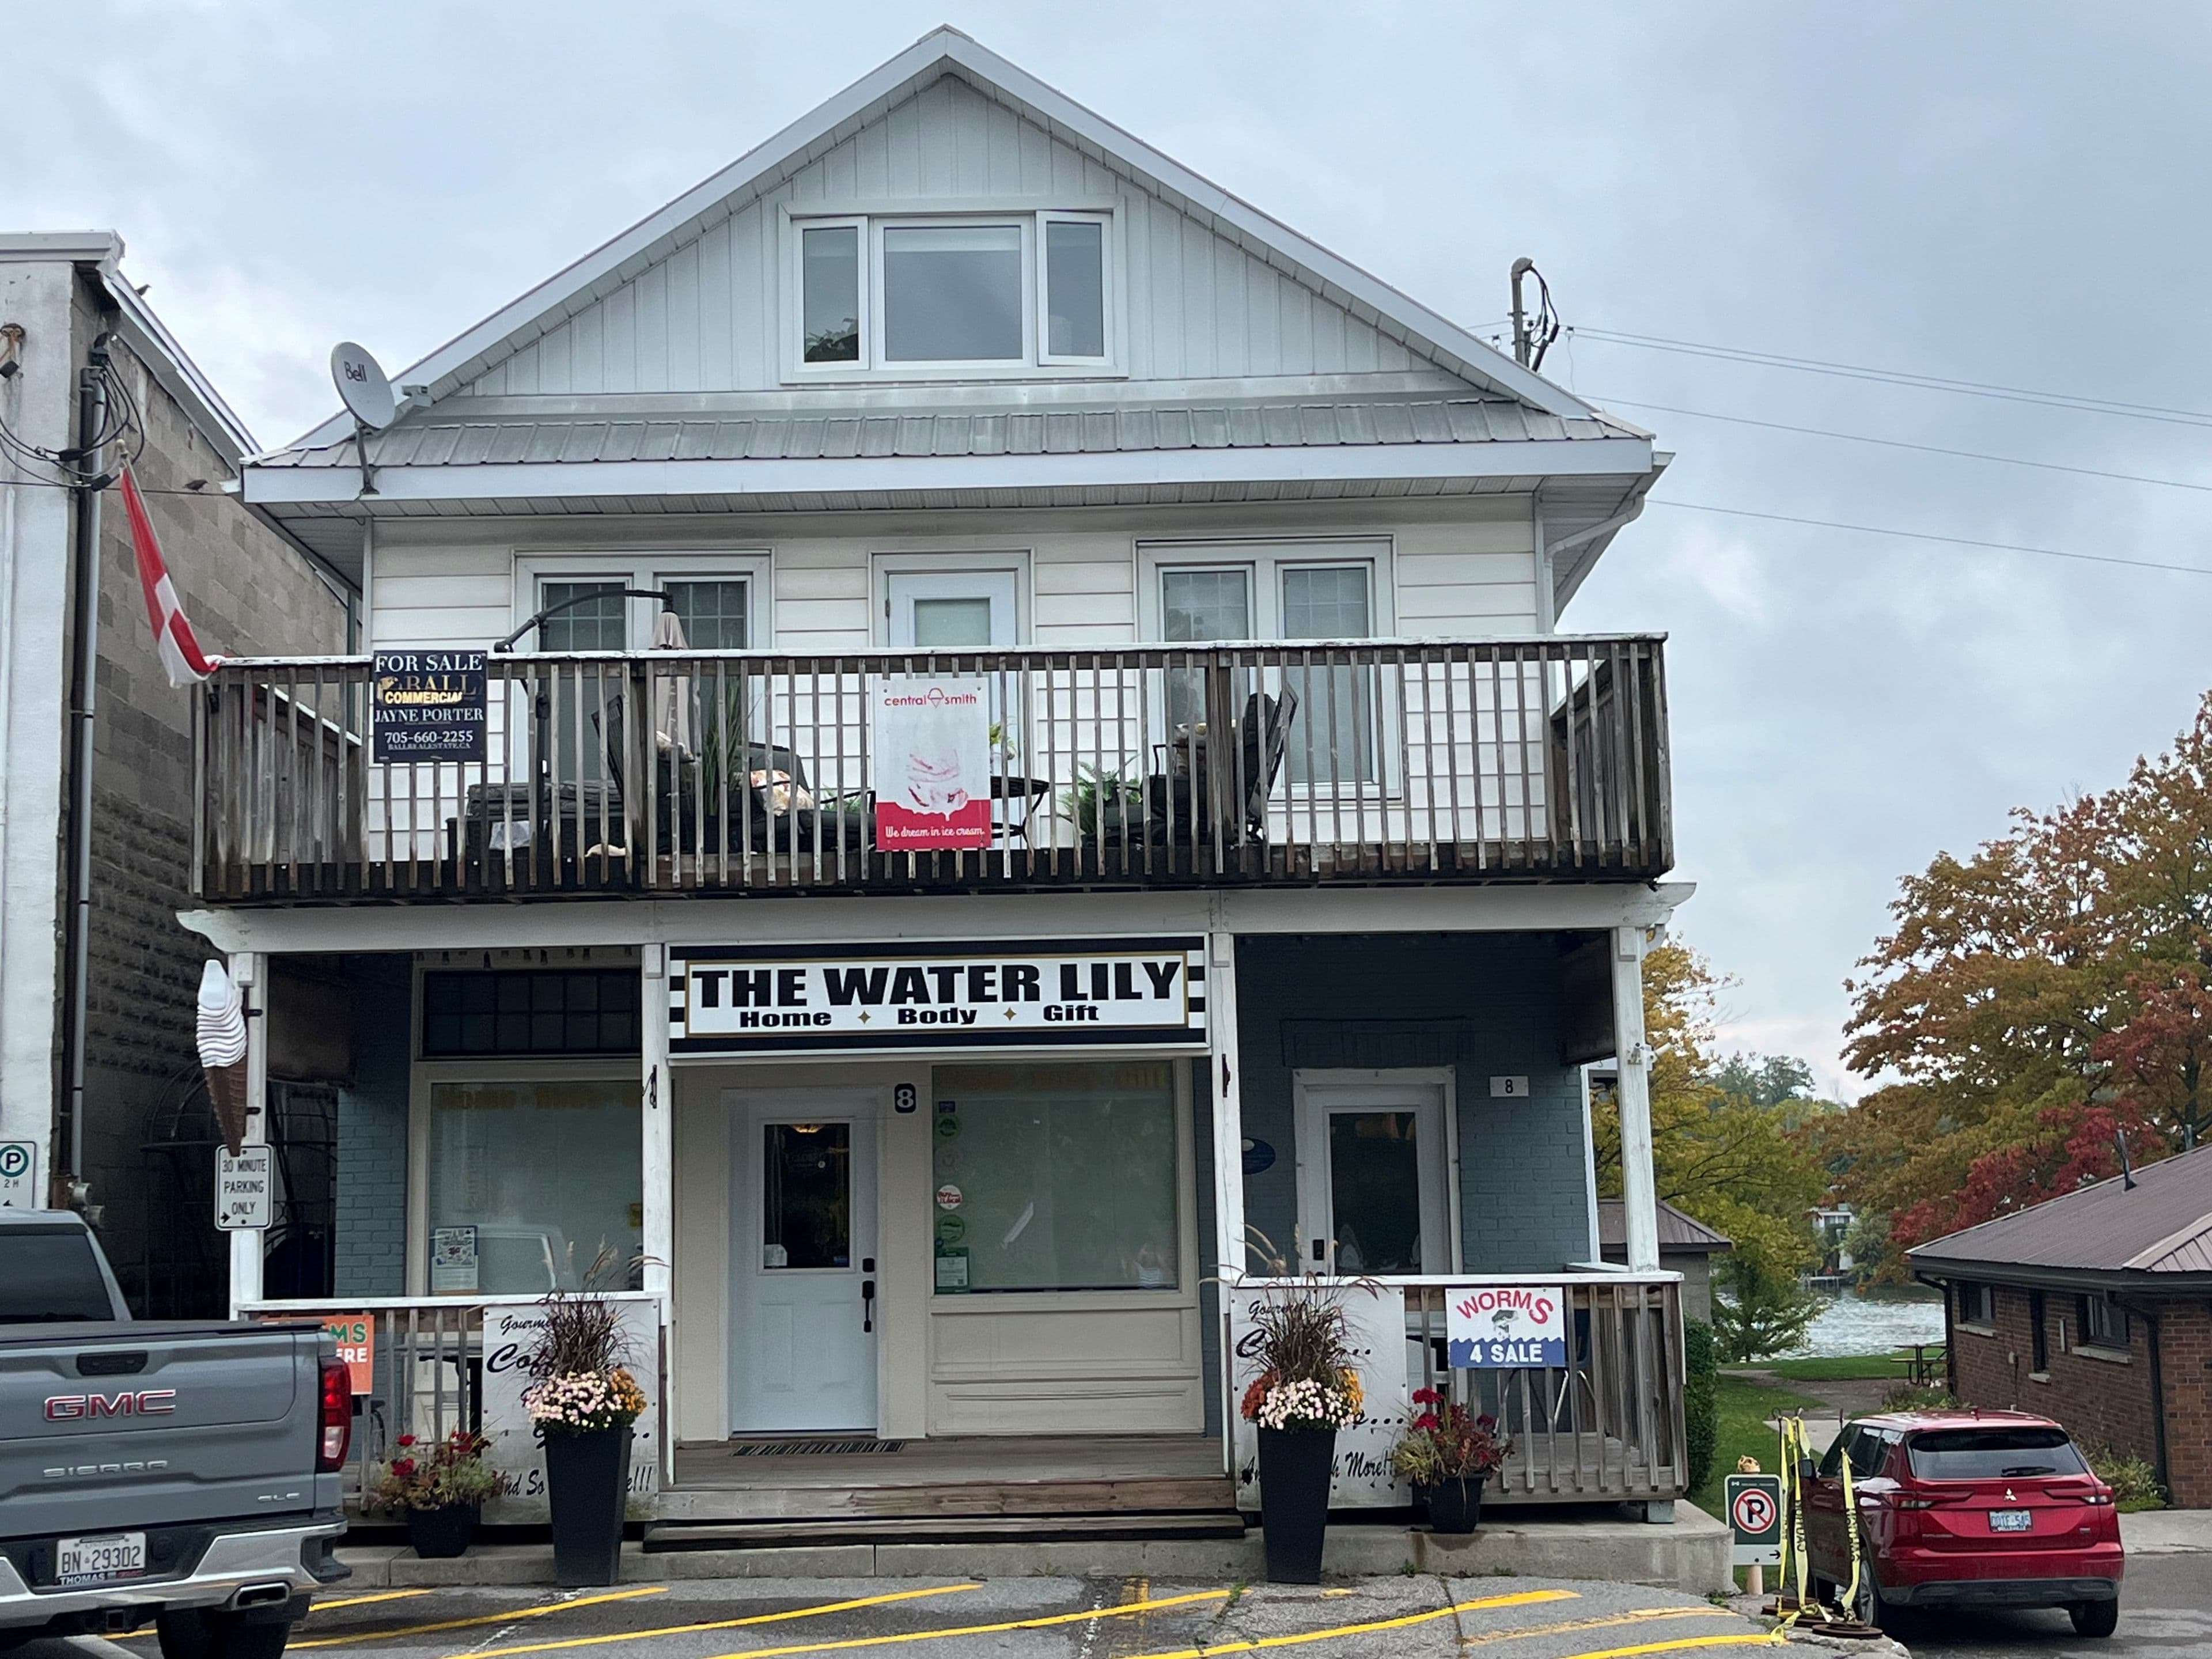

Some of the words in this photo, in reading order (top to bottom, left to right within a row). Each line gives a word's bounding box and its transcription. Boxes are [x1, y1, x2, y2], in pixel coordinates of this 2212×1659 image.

[344, 361, 367, 382] Bell
[375, 656, 419, 672] FOR
[426, 654, 482, 671] SALE
[884, 695, 926, 706] central
[945, 693, 977, 705] smith
[375, 709, 419, 722] JAYNE
[422, 708, 484, 721] PORTER
[385, 730, 474, 743] 705-660-2255
[885, 825, 900, 838] We
[900, 826, 930, 837] dream
[930, 826, 940, 836] in
[941, 825, 955, 836] ice
[692, 969, 807, 1008] THE
[823, 964, 1040, 1006] WATER
[1060, 961, 1181, 1001] LILY
[740, 1010, 832, 1028] Home
[898, 1006, 978, 1025] Body
[1043, 1004, 1100, 1022] Gift
[1505, 1079, 1513, 1094] 8
[897, 1089, 914, 1108] 8
[6, 1153, 21, 1170] P
[222, 1160, 233, 1172] 30
[237, 1158, 267, 1172] MINUTE
[4, 1179, 10, 1188] 2
[13, 1179, 18, 1188] H
[224, 1180, 264, 1194] PARKING
[232, 1201, 256, 1215] ONLY
[1456, 1290, 1554, 1324] WORMS
[1470, 1344, 1483, 1363] 4
[1490, 1343, 1543, 1363] SALE
[45, 1389, 176, 1422] GMC
[43, 1460, 168, 1478] SIERRA
[1747, 1499, 1764, 1524] P
[62, 1551, 81, 1574] BN
[92, 1546, 141, 1570] 29302
[59, 1573, 106, 1585] THOMAS
